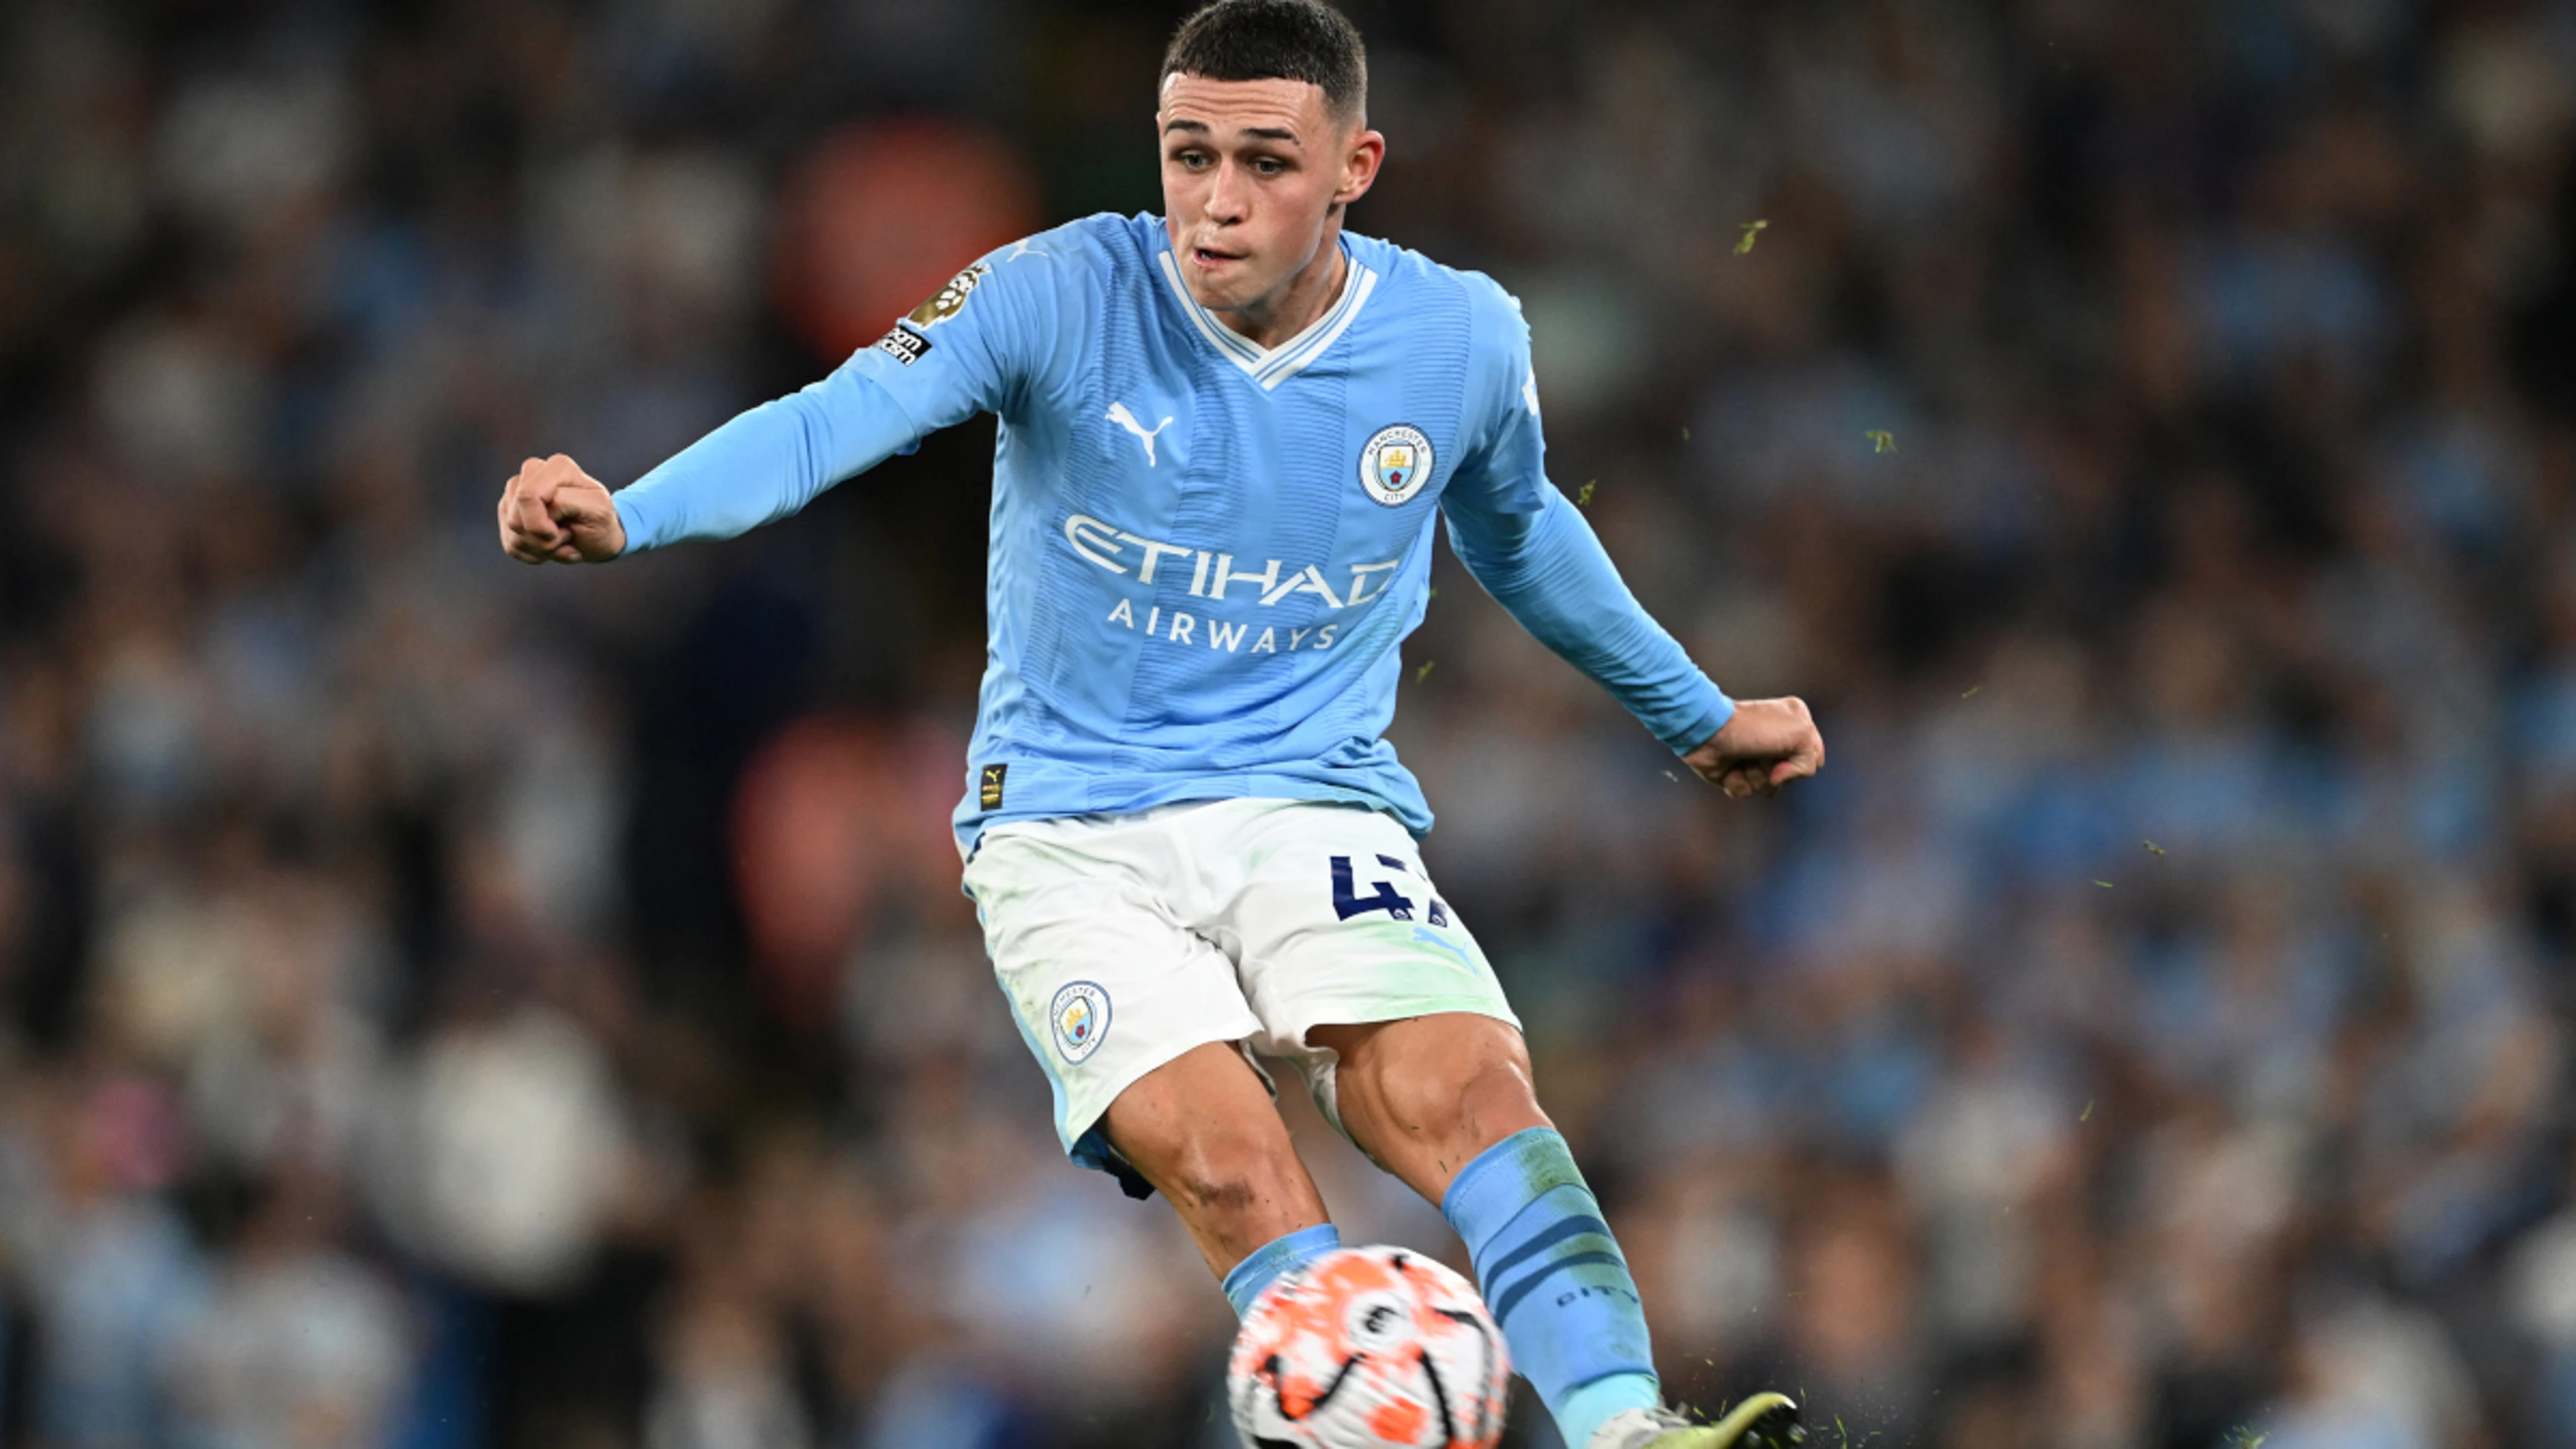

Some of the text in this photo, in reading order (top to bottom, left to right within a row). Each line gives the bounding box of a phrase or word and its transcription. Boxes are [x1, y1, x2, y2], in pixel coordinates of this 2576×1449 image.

[1368, 429, 1428, 455] MANCHESTER
[1384, 493, 1405, 501] CITY
[1064, 513, 1399, 609] ETIHAD
[1108, 598, 1339, 653] AIRWAYS
[1556, 1285, 1640, 1307] CITY
